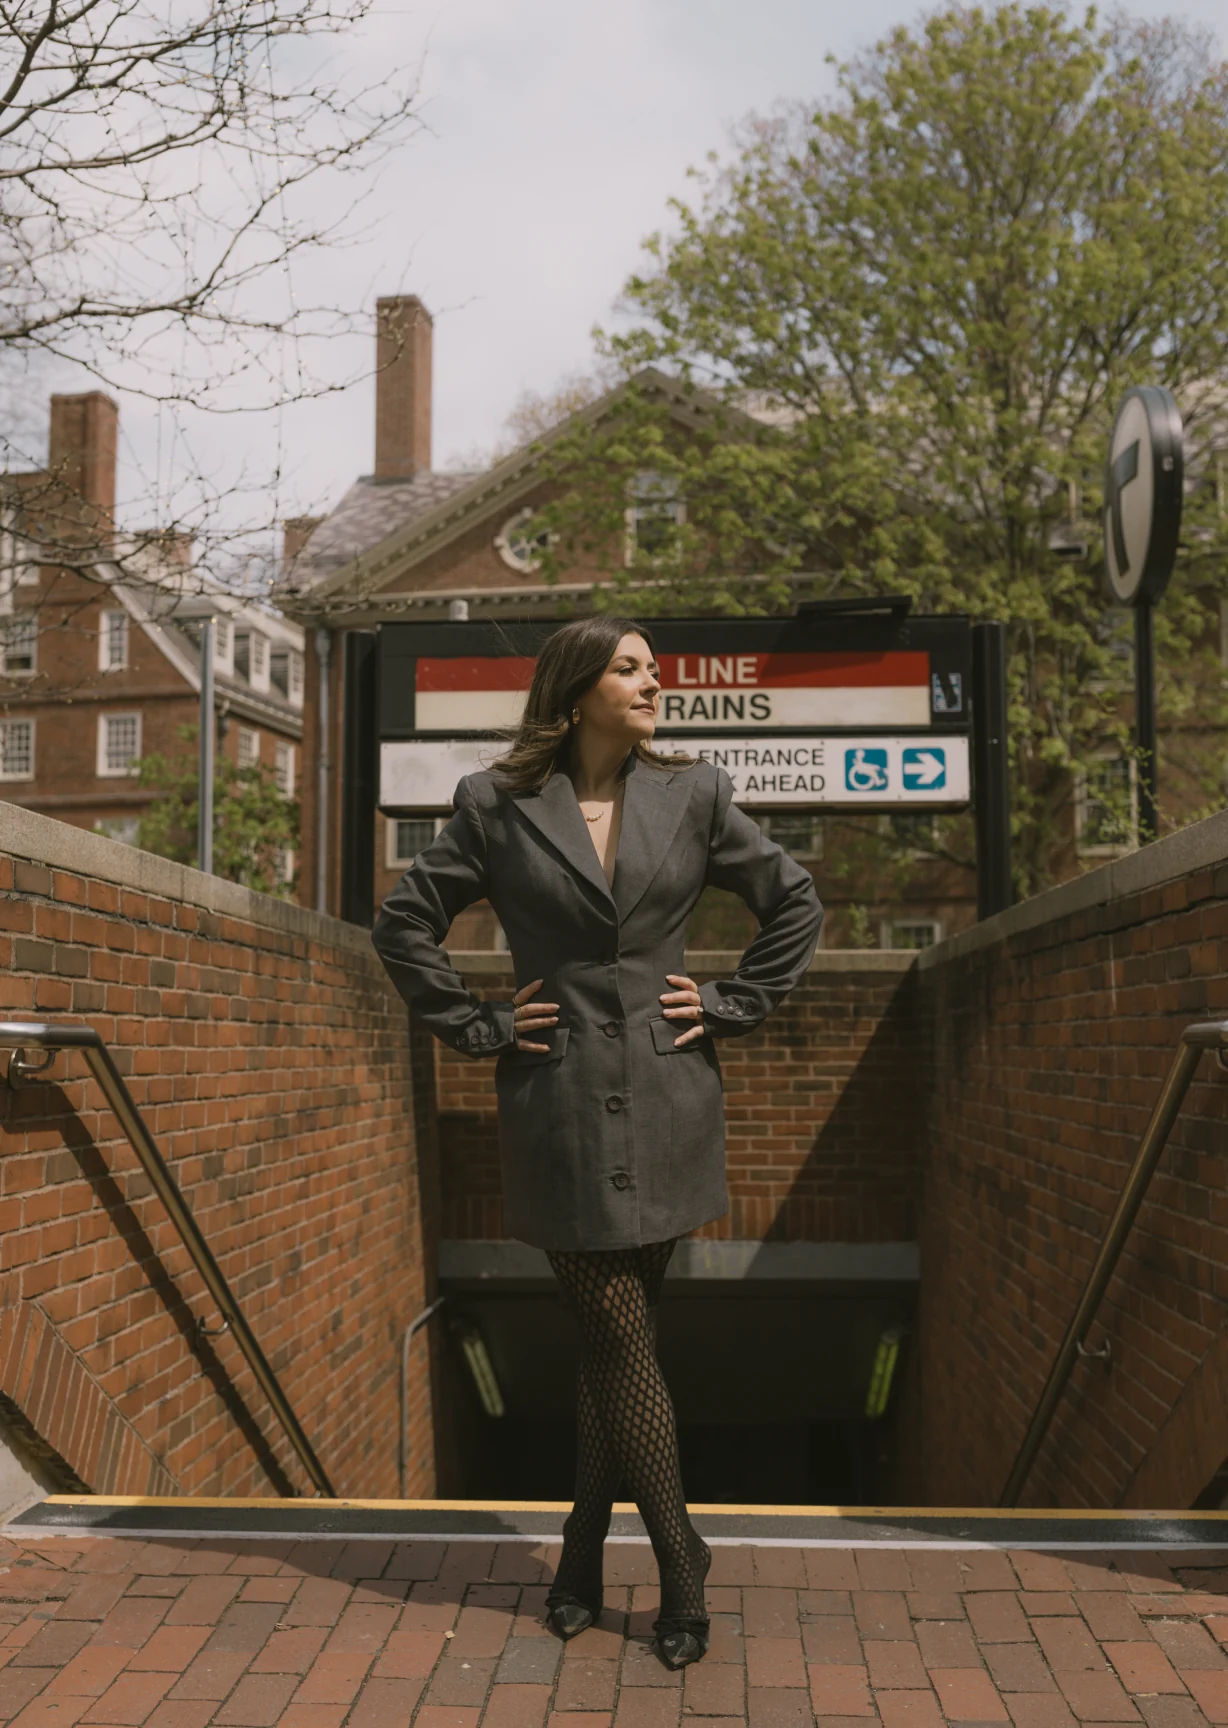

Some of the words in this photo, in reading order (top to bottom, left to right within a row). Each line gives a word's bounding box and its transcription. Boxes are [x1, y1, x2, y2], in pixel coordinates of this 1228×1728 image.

[677, 656, 758, 685] LINE
[657, 693, 771, 721] RAINS
[745, 774, 825, 792] AHEAD
